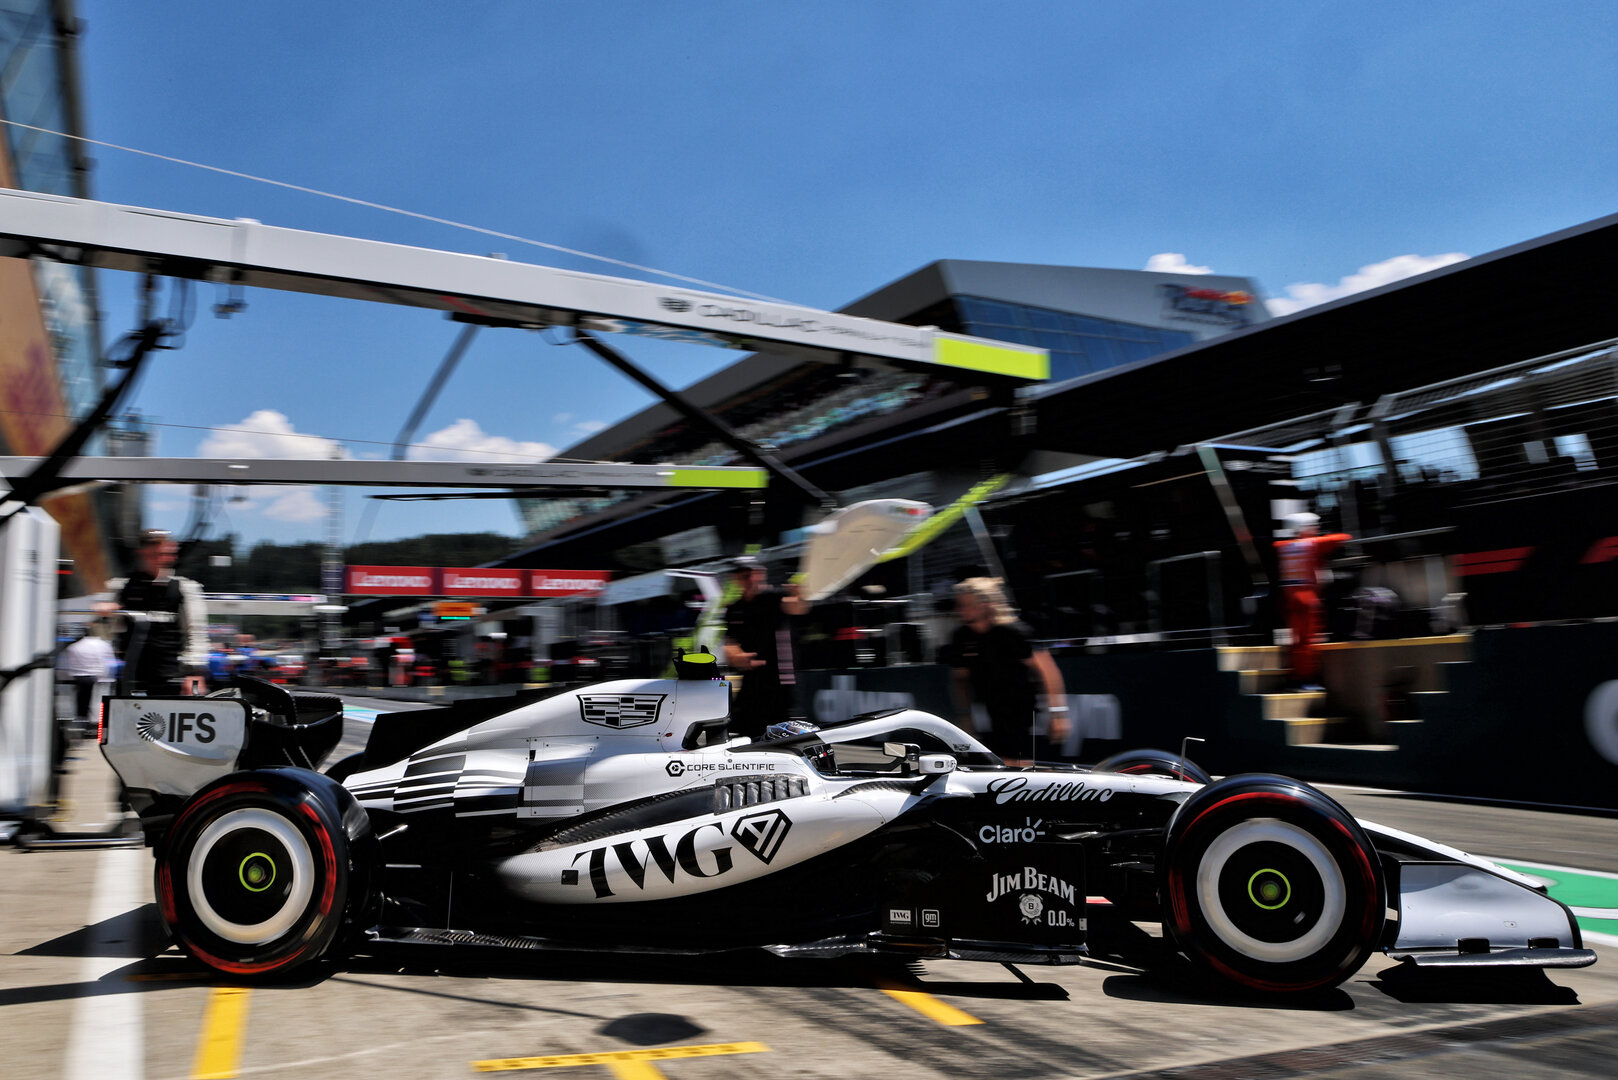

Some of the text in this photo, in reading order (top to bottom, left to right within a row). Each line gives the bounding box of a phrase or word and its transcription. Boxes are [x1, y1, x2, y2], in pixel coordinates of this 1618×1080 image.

[351, 572, 432, 588] Lenovo
[443, 573, 522, 589] Lenovo
[532, 575, 606, 591] Lenovo
[168, 712, 216, 743] IFS
[986, 777, 1115, 804] Cadillac
[979, 823, 1037, 843] Claro
[571, 822, 734, 899] TWG
[986, 867, 1075, 906] JIM BEAM
[891, 911, 909, 919] TWG
[925, 913, 937, 923] gm
[1048, 910, 1075, 927] 0.0%
